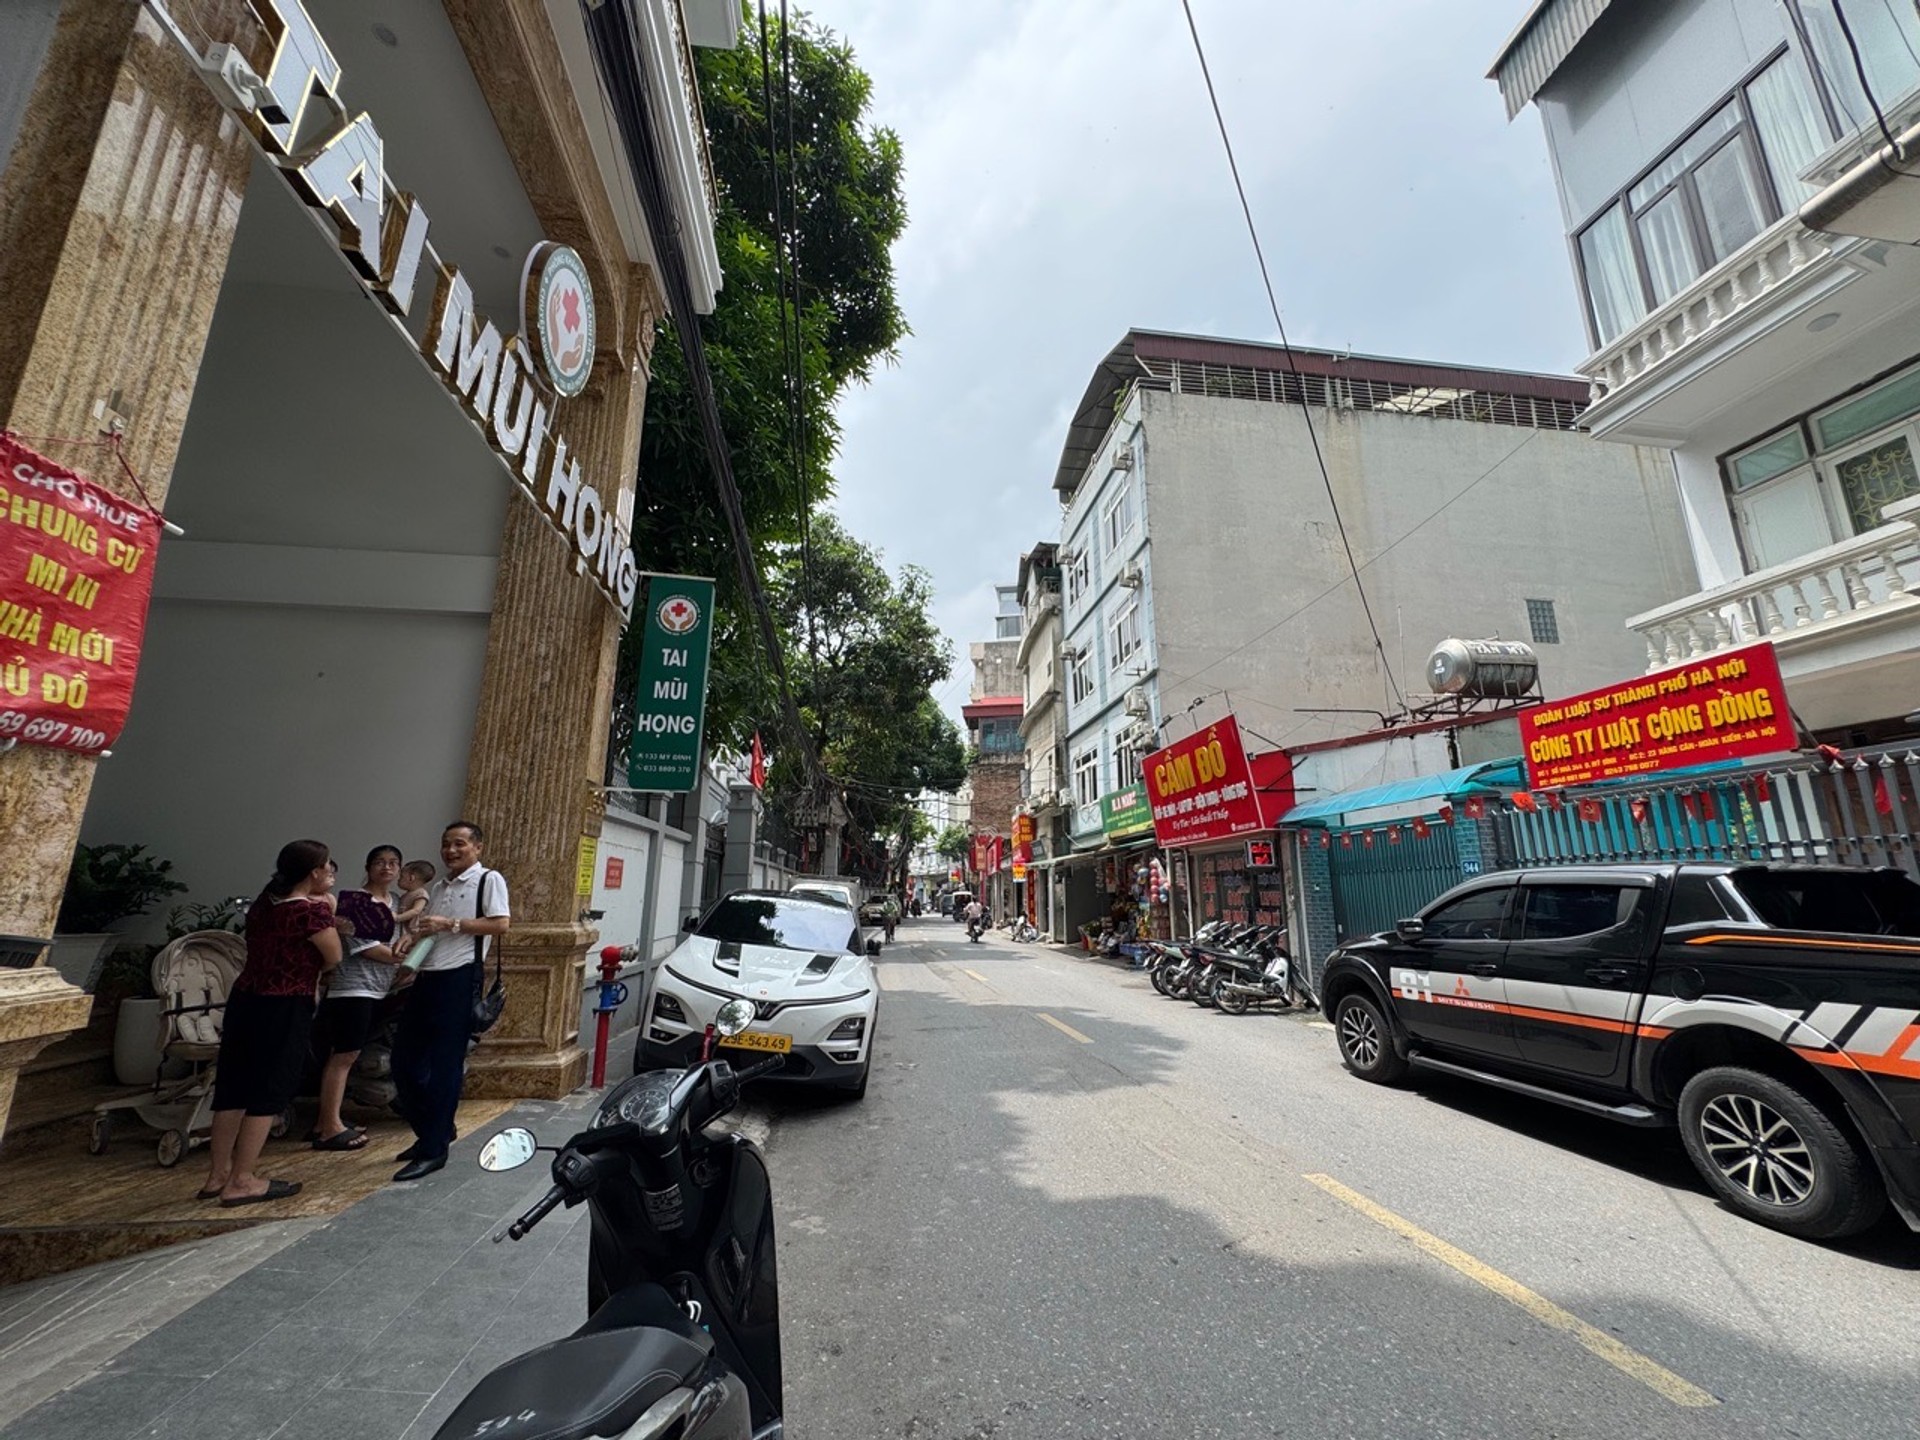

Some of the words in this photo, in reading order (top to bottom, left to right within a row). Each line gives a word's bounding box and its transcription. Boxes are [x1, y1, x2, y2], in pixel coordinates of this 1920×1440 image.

[255, 0, 431, 317] TAI
[436, 265, 550, 486] MŨI
[546, 436, 638, 609] HỌNG
[12, 463, 77, 499] CHO
[82, 490, 140, 533] THUÊ
[106, 537, 145, 574] CƯ
[25, 553, 68, 595] MI
[66, 572, 101, 610] NI
[48, 621, 114, 666] MỚI
[662, 648, 687, 667] TAI
[0, 655, 30, 697] Ủ
[653, 677, 688, 700] MŨI
[1533, 709, 1563, 727] ĐOÀN
[1564, 700, 1591, 719] LUẬT
[1593, 694, 1612, 711] SƯ
[1611, 683, 1657, 707] THÀNH
[1658, 671, 1688, 694] PHỐ
[1690, 666, 1714, 687] HÀ
[1716, 659, 1747, 679] NỘI
[24, 717, 68, 742] 697
[66, 726, 106, 749] 700
[638, 714, 695, 738] HỌNG
[1530, 732, 1573, 764] CÔNG
[1573, 728, 1593, 754] TY
[1597, 715, 1640, 750] LUẬT
[1647, 703, 1704, 741] CỘNG
[1705, 688, 1774, 728] ĐỒNG
[1155, 748, 1197, 798] CẦM
[1194, 726, 1227, 784] ĐỒ
[1437, 996, 1496, 1010] MITSUBISHI
